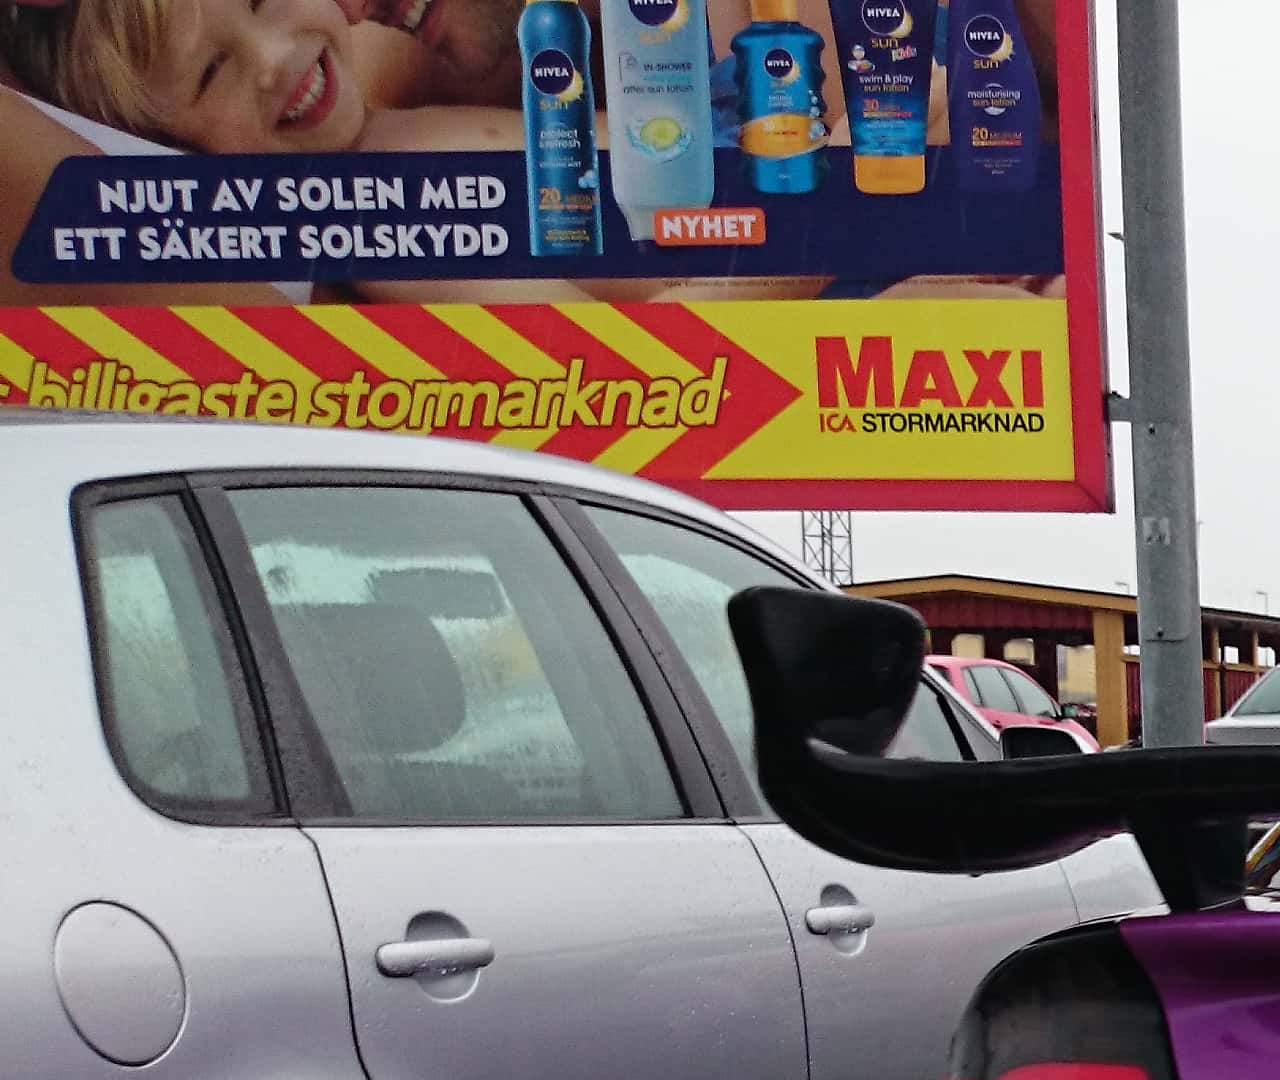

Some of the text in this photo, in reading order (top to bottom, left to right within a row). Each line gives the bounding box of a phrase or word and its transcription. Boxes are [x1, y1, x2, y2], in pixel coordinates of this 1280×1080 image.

[867, 7, 900, 18] NIVEA
[969, 31, 1001, 41] NIVEA
[871, 38, 899, 49] sun
[766, 59, 791, 68] NIVEA
[972, 59, 1000, 70] sun
[534, 66, 570, 78] NIVEA
[858, 75, 883, 84] swim
[892, 74, 914, 85] play
[972, 127, 989, 142] 20
[99, 175, 506, 214] NJUT AV SOLEN MED
[661, 214, 757, 240] NYHET
[53, 217, 509, 261] ETT SÄKERT SOLSKYDD
[815, 335, 1045, 408] MAXI
[310, 356, 729, 429] stormarknad
[819, 412, 1046, 433] ICA STORMARKNAD
